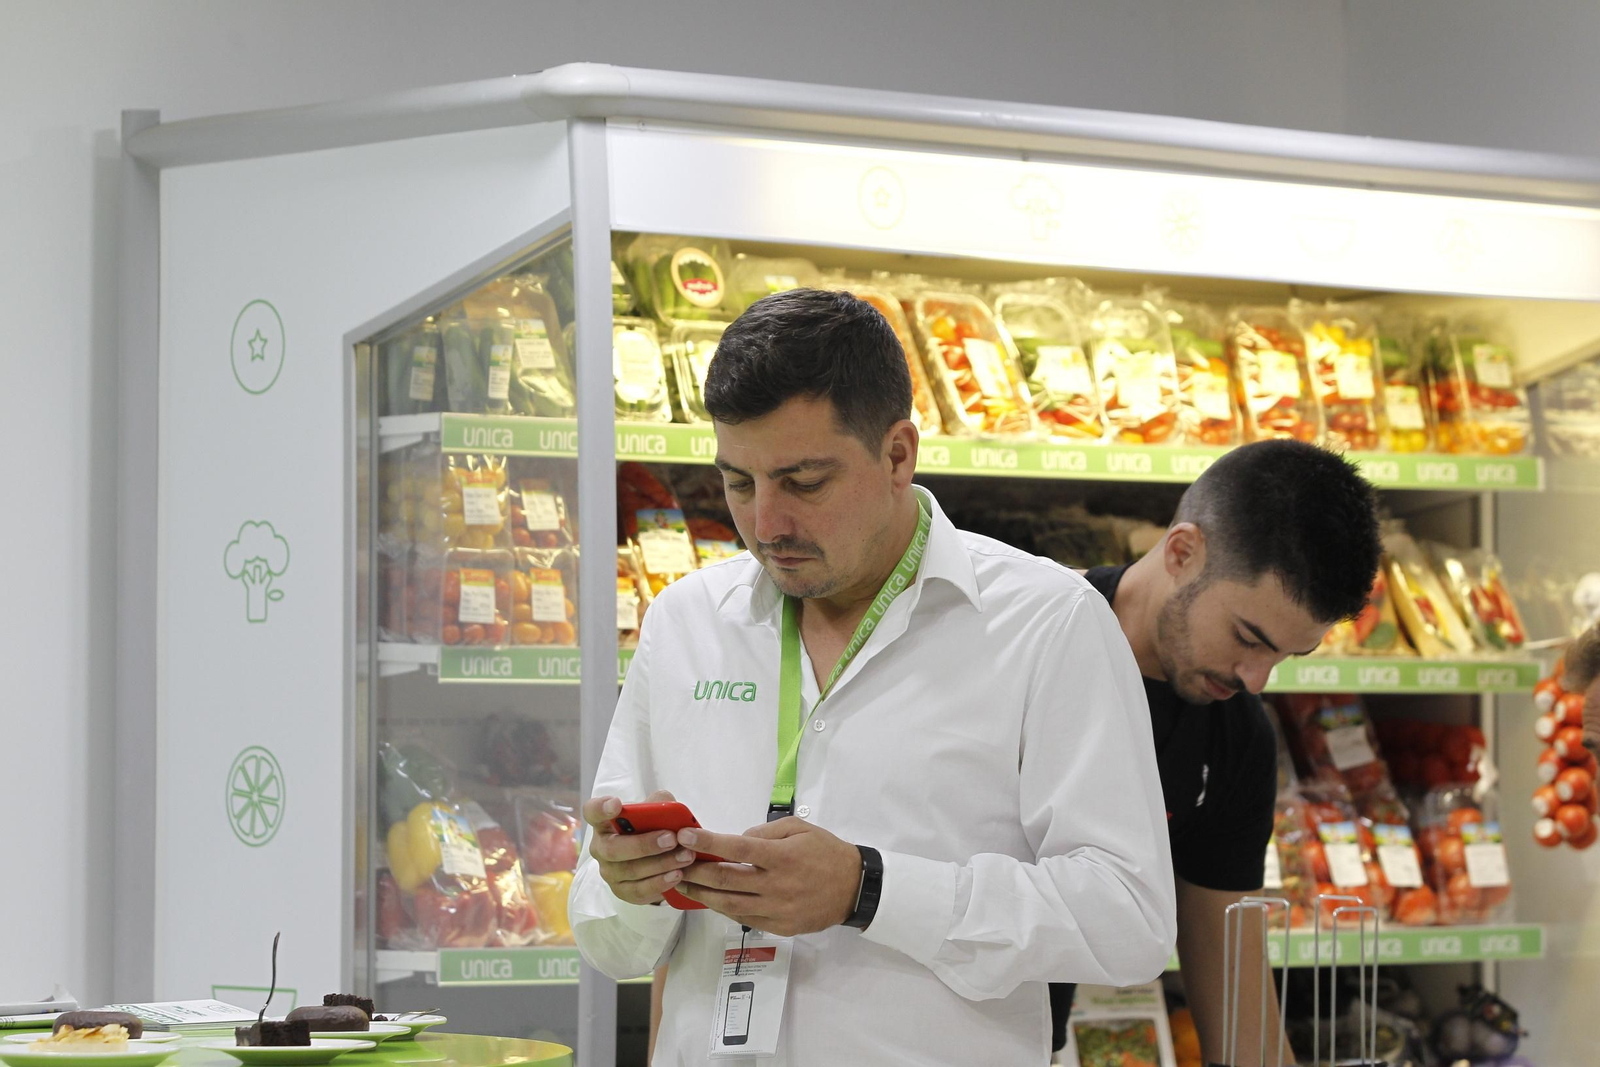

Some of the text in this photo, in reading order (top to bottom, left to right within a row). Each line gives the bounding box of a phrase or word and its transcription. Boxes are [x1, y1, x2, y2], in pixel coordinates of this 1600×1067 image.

[540, 430, 578, 450] unic
[694, 680, 757, 702] unica
[538, 957, 579, 977] unic
